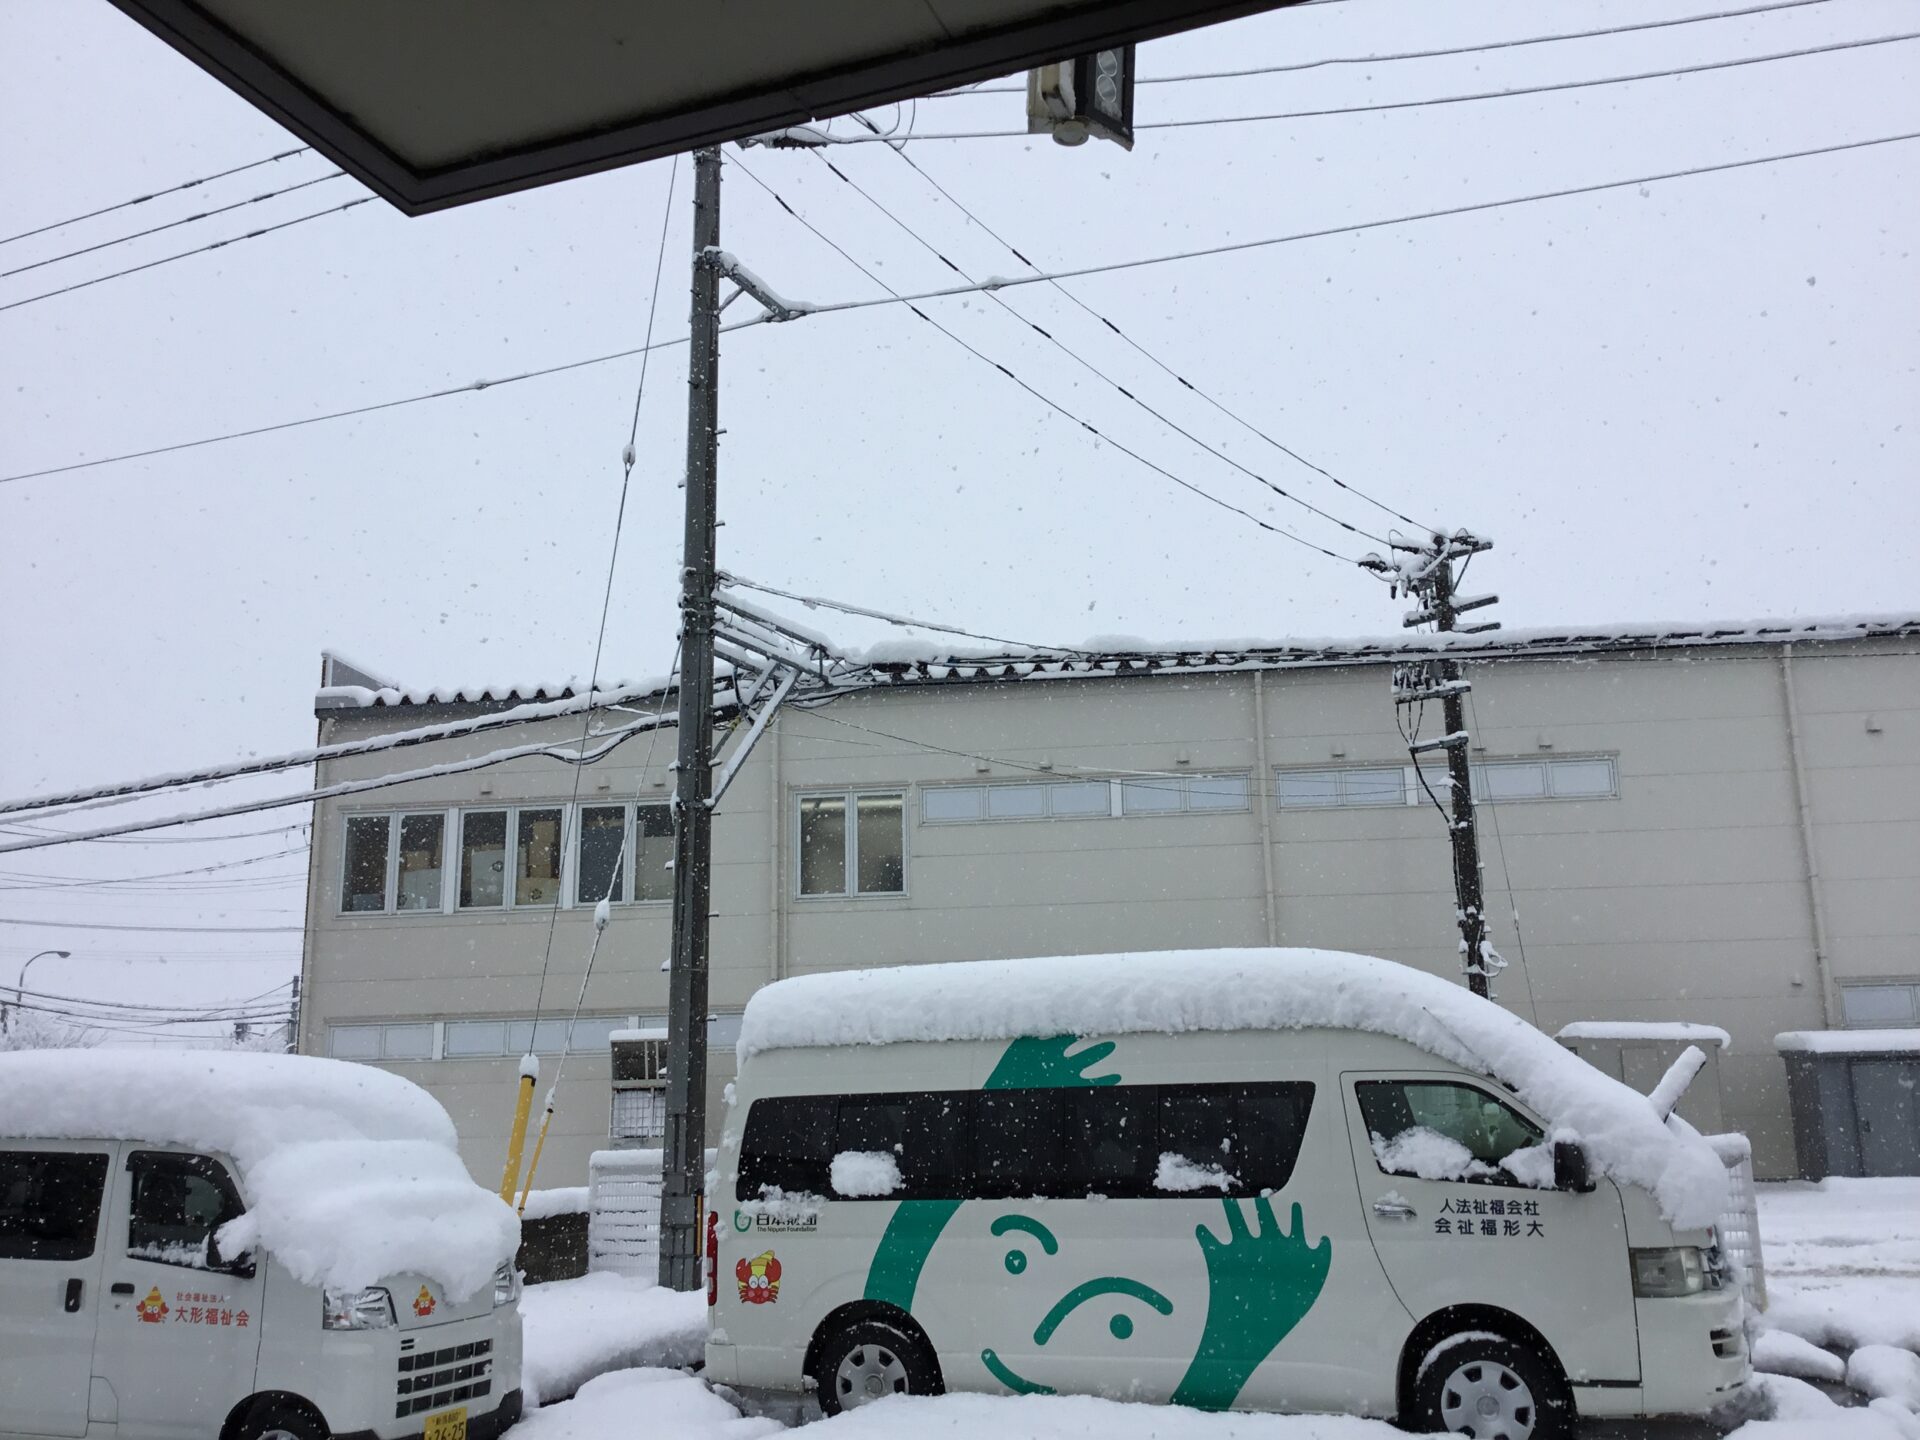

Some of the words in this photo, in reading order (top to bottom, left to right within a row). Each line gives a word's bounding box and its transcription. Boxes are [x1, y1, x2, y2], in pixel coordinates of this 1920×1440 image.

[174, 1306, 250, 1327] 大形福祉会
